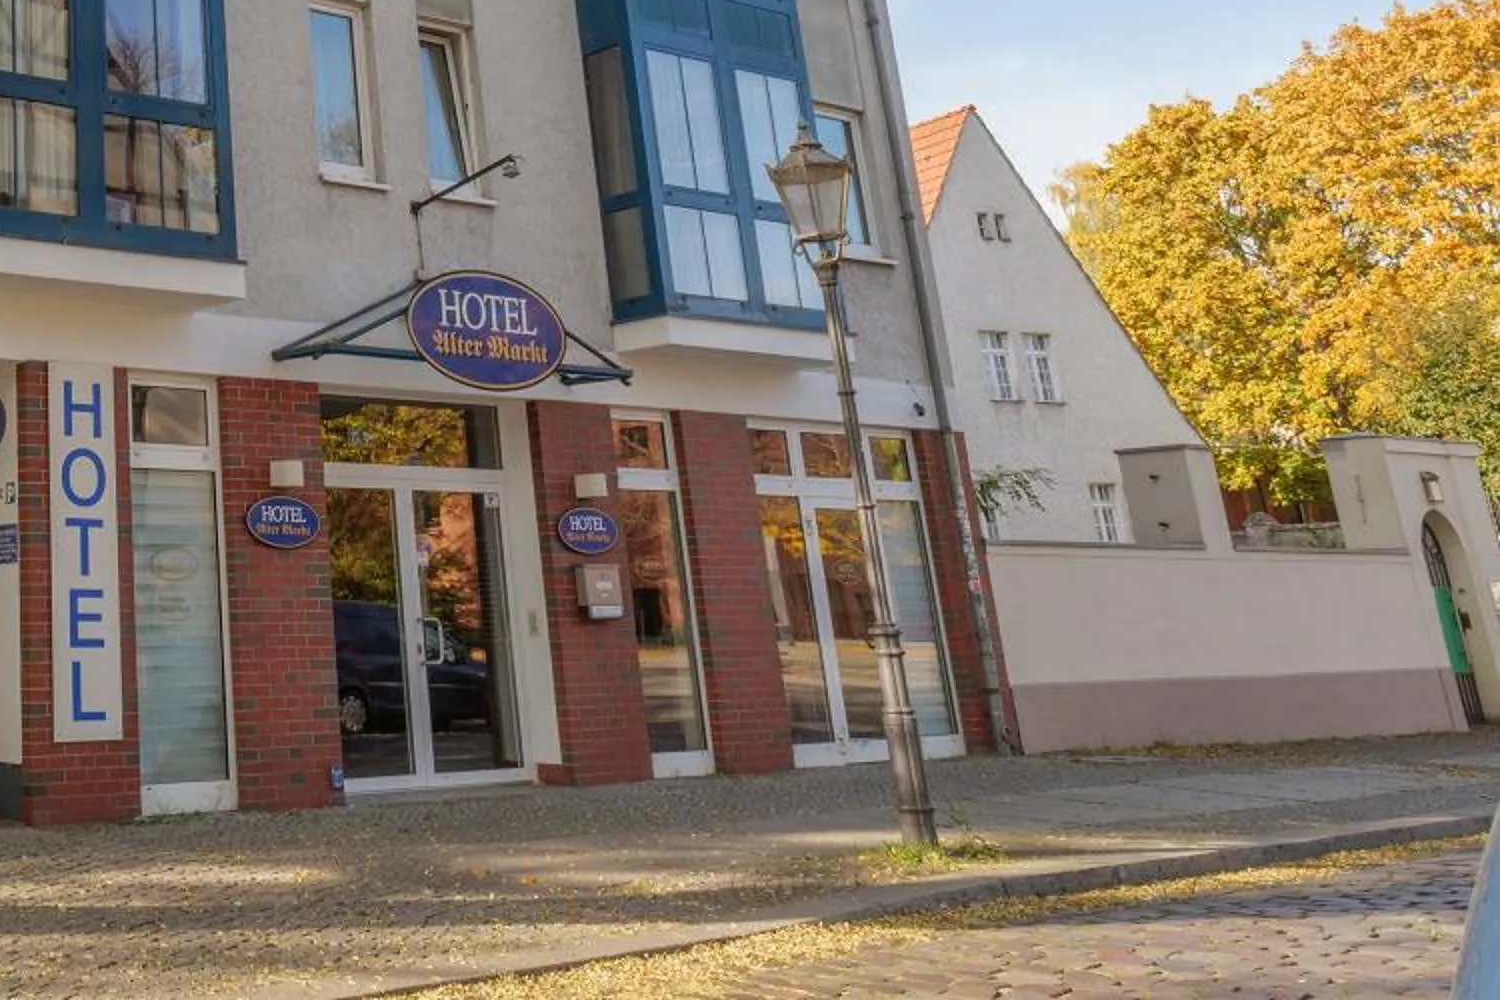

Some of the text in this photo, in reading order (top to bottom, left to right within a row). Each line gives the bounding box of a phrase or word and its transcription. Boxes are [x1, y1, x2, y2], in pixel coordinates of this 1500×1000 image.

[438, 288, 537, 336] HOTEL
[432, 329, 549, 364] Alter Markt
[261, 505, 307, 524] HOTEL
[569, 515, 606, 531] HOTEL
[61, 380, 107, 722] HOTEL
